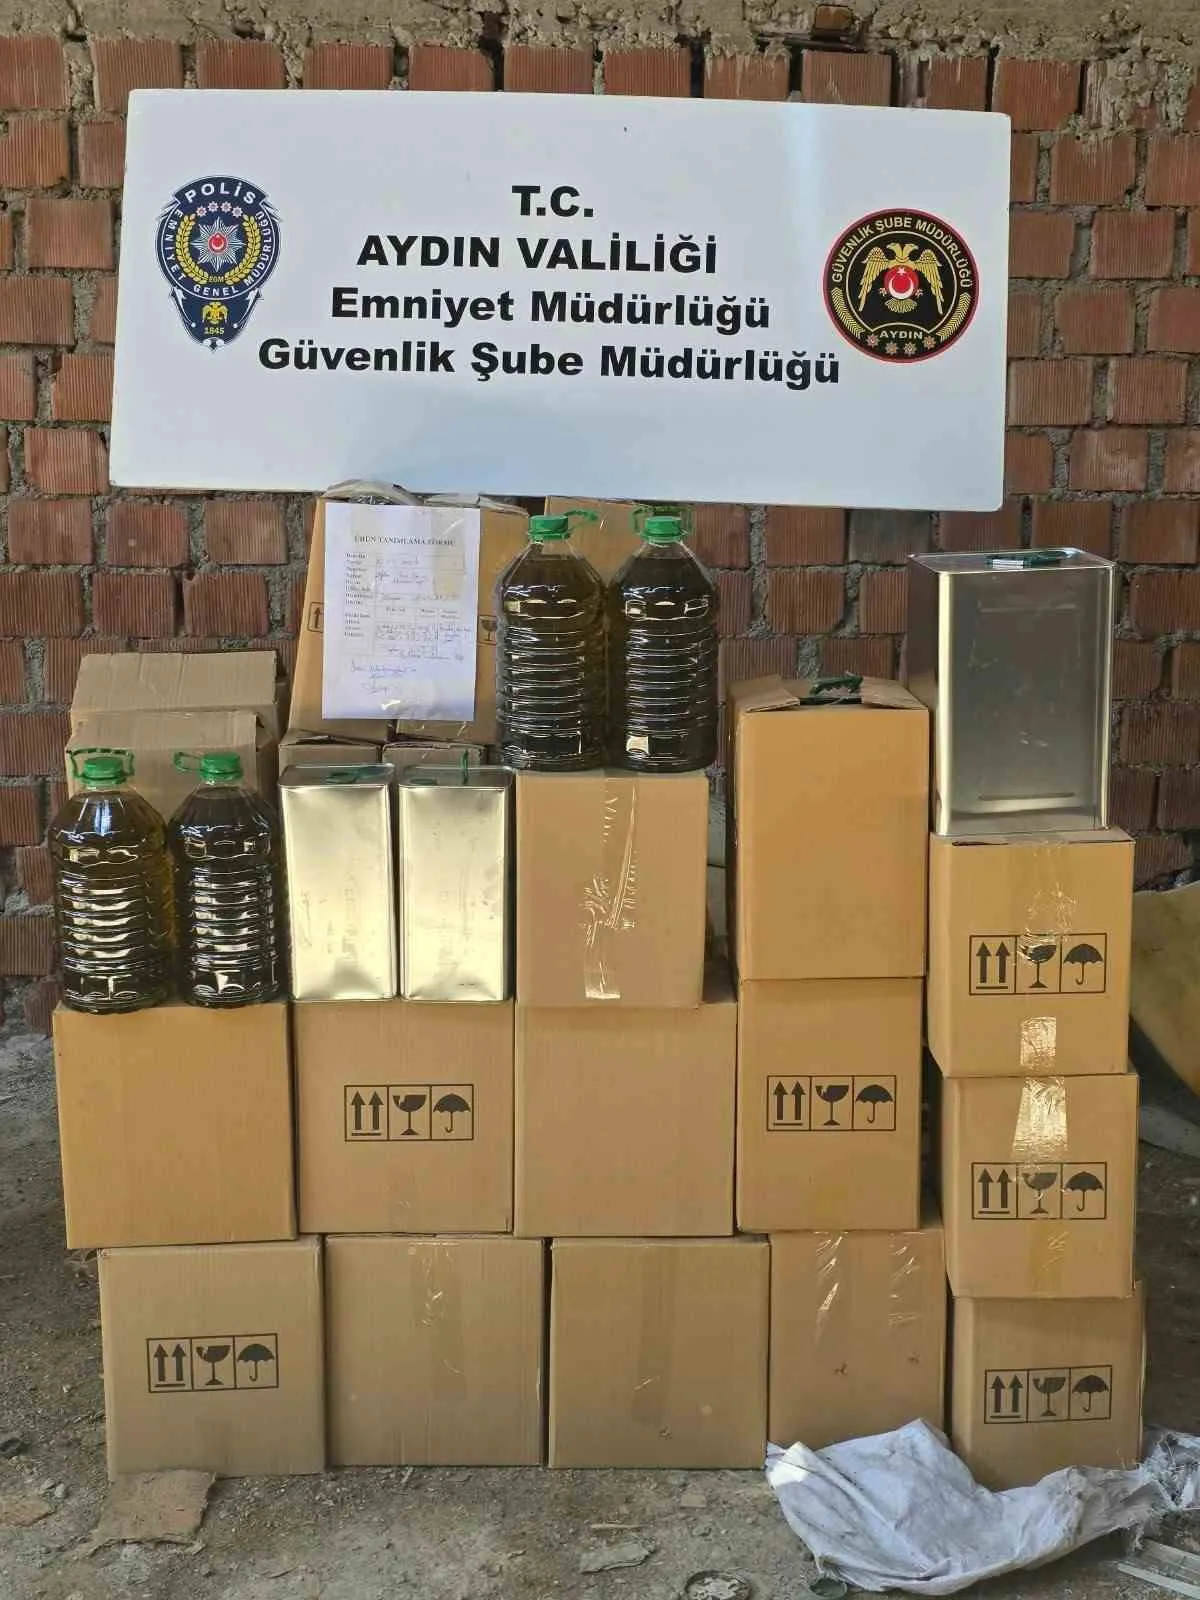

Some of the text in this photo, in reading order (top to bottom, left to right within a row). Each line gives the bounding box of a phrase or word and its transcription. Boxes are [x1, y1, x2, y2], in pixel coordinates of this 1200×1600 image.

[184, 182, 256, 205] POLİS
[511, 185, 594, 218] T.C.
[356, 232, 717, 274] AYDIN VALİLİĞİ
[831, 216, 973, 288] GÜVENLİK ŞUBE MÜDÜRLÜĞÜ
[192, 283, 240, 297] GENEL
[331, 286, 770, 336] Emniyet Müdürlüğü
[879, 329, 924, 340] AYDIN
[258, 338, 839, 391] Güvenlik Şube Müdürlüğü
